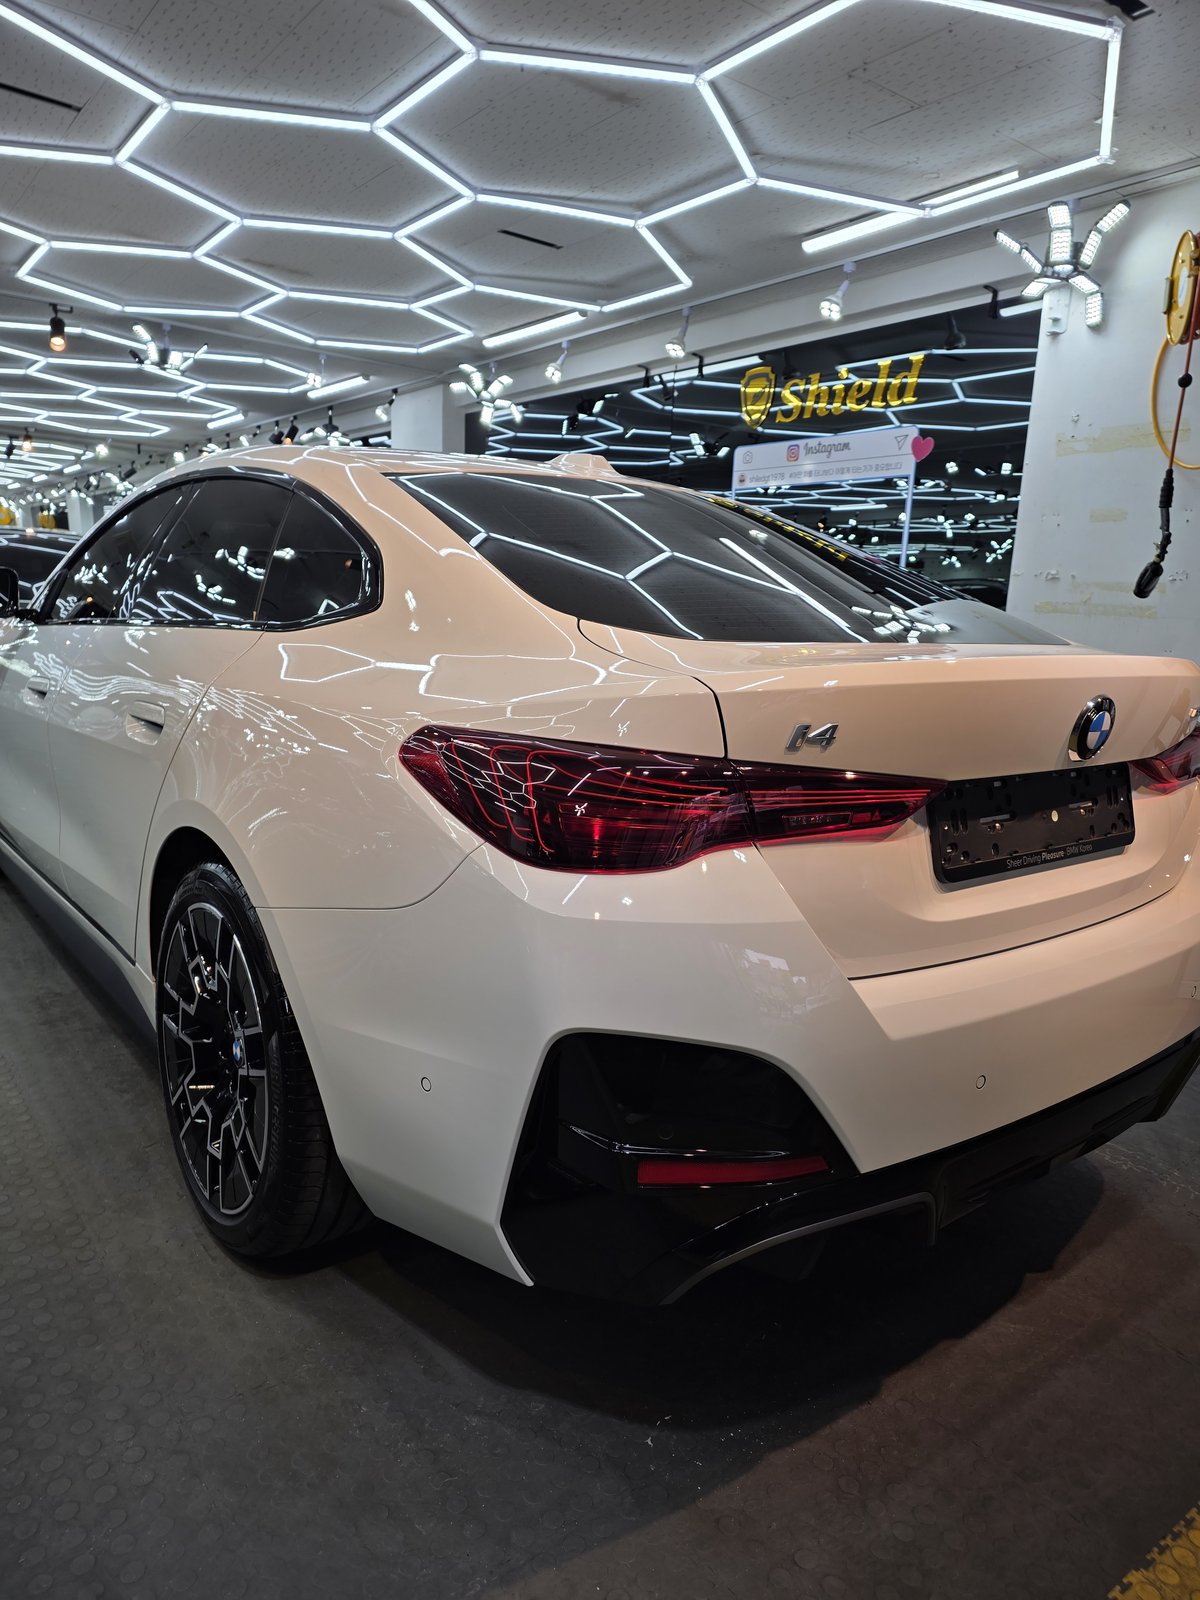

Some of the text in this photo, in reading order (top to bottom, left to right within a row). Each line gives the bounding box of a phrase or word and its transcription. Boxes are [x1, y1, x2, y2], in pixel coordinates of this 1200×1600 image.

[775, 354, 925, 423] Shield
[803, 440, 851, 458] Instagram
[786, 723, 838, 752] i4
[1007, 843, 1093, 869] Sheer Driving Pleasure BMW Korea
